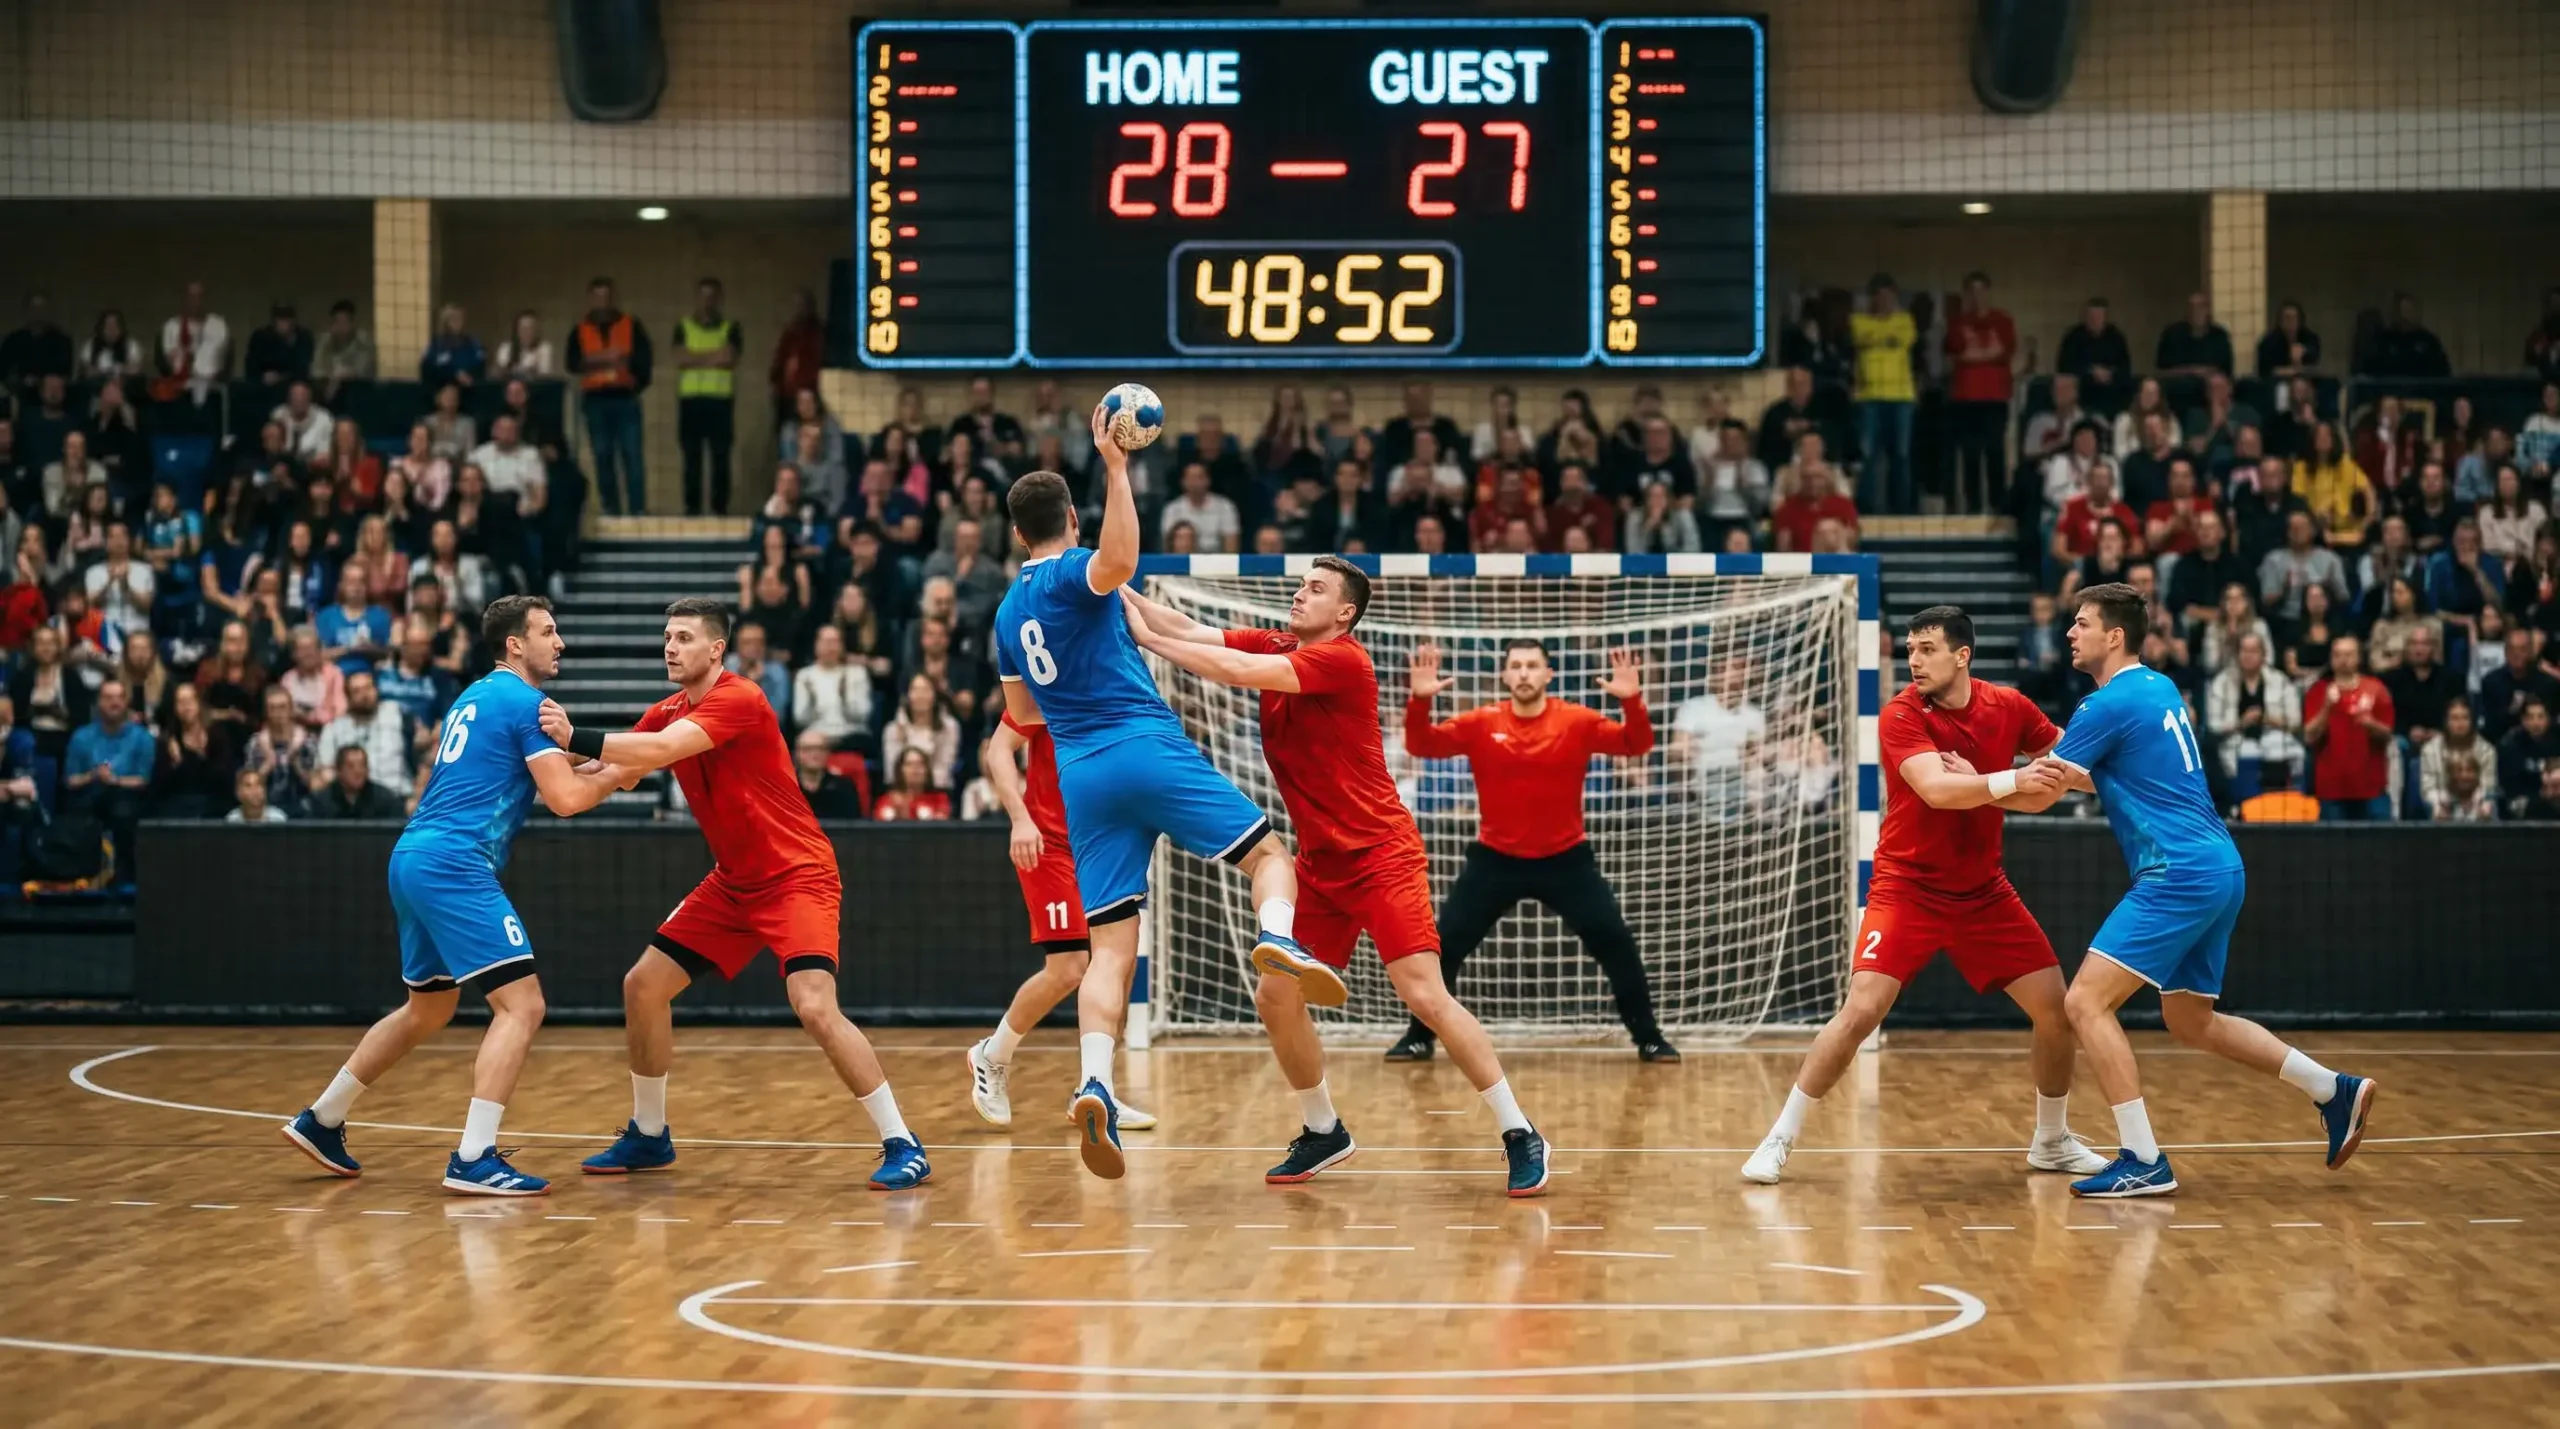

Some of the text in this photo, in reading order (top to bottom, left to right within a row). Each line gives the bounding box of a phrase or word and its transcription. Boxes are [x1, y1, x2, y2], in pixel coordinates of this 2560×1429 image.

[869, 75, 891, 106] 2
[1086, 50, 1240, 105] HOME
[1370, 49, 1549, 104] GUEST
[1609, 74, 1631, 104] 2
[872, 110, 891, 142] 3
[1612, 109, 1631, 140] 3
[870, 147, 892, 175] 4
[1109, 122, 1231, 217] 28
[1408, 122, 1530, 217] 27
[1609, 145, 1631, 173] 4
[871, 181, 891, 212] 5
[1610, 180, 1631, 210] 5
[870, 216, 891, 247] 6
[1609, 215, 1631, 246] 6
[872, 251, 892, 281] 7
[1612, 250, 1631, 279] 7
[869, 285, 892, 317] 9
[1196, 255, 1443, 342] 48:52
[1609, 284, 1631, 316] 9
[1021, 619, 1058, 685] 8
[435, 704, 476, 765] 16
[2163, 707, 2202, 772] 11
[503, 915, 524, 946] 6
[1046, 901, 1068, 930] 11
[1862, 930, 1882, 959] 2
